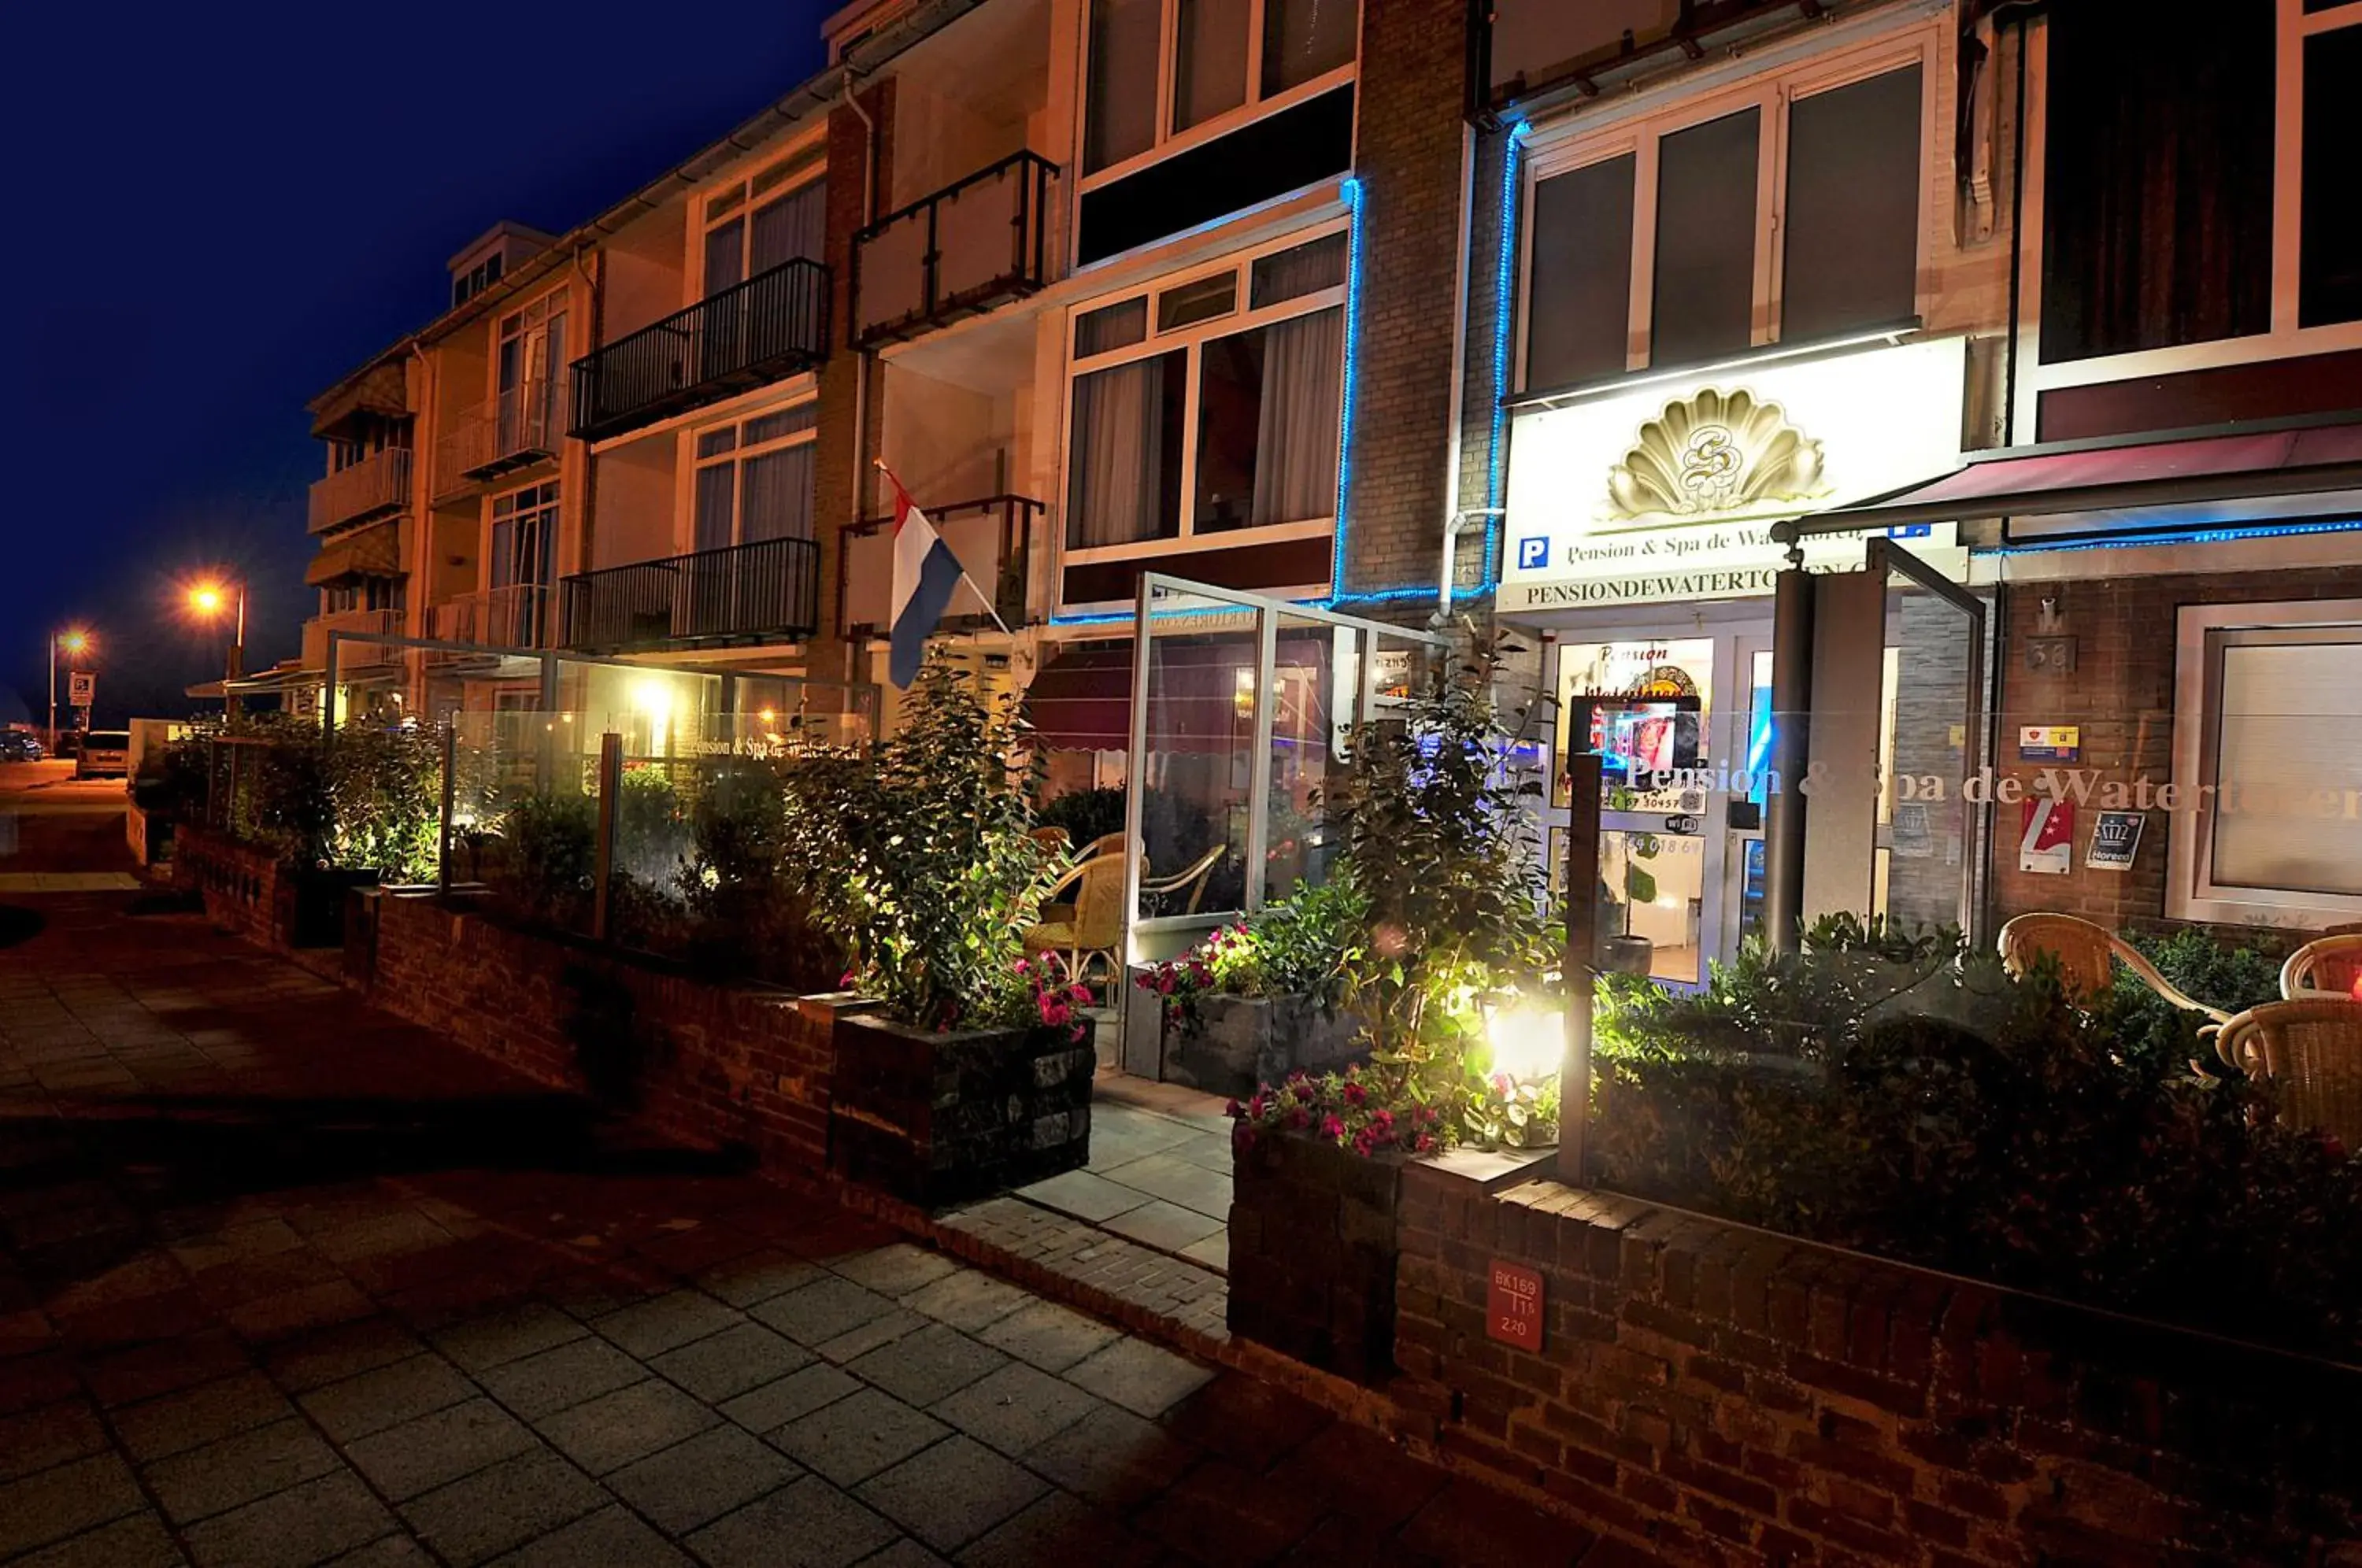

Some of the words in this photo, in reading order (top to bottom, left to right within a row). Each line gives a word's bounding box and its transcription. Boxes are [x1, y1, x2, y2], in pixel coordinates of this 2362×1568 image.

[1522, 538, 1546, 568] P
[1568, 542, 1635, 564] Pension
[1641, 539, 1657, 556] &
[1664, 536, 1701, 557] Spa
[1706, 533, 1731, 549] de
[1601, 645, 1668, 661] Pnsion
[1623, 756, 1783, 795] Pension
[1798, 760, 1838, 797] &
[1854, 762, 1947, 814] pa
[1962, 765, 2023, 804] de
[2040, 767, 2362, 822] Waterten
